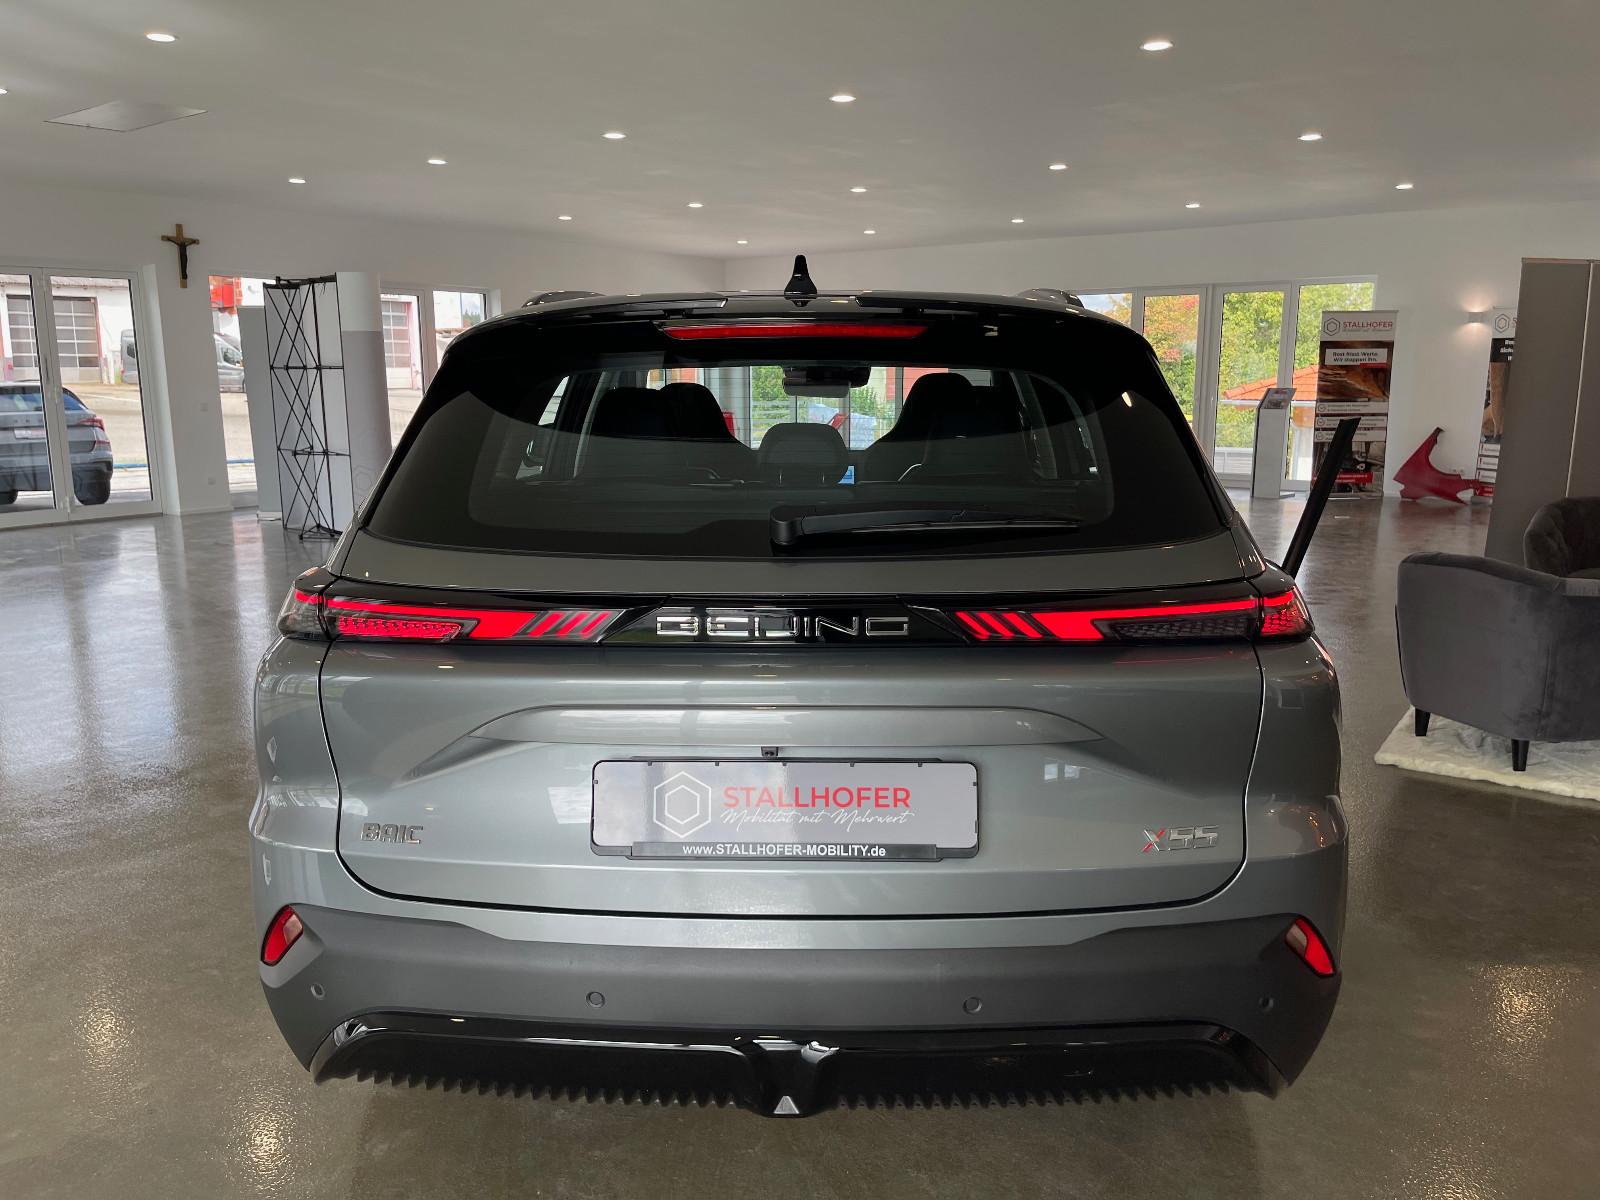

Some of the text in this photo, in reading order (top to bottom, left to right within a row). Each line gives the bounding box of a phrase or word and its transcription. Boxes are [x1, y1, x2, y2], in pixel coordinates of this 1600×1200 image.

[1343, 321, 1393, 329] STALLHOFER
[656, 616, 909, 637] BEIJING
[722, 786, 912, 809] STALLHOFER
[799, 809, 828, 824] mit
[830, 809, 915, 833] Mehrwert
[360, 823, 424, 845] BAIC
[1142, 825, 1220, 853] X55
[682, 843, 886, 857] www.STALLHOFER-MOBILITY.de
